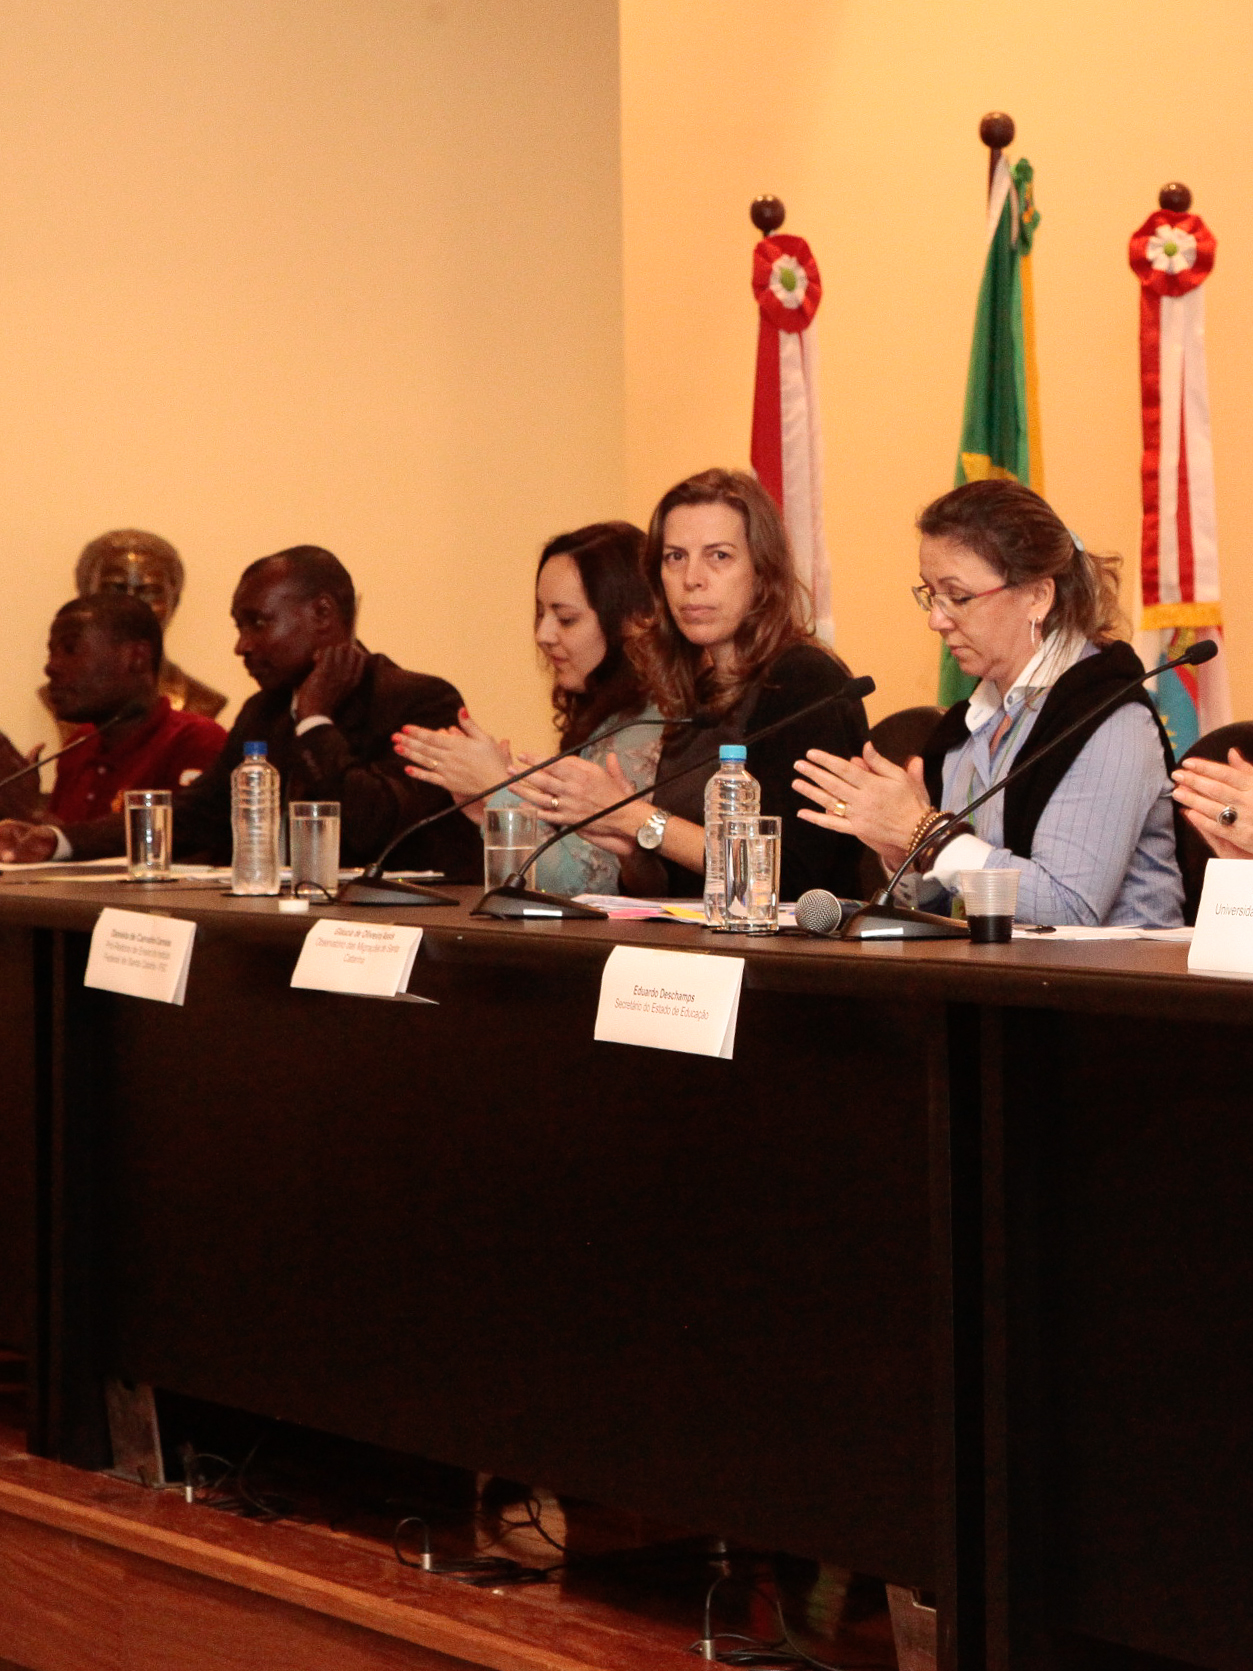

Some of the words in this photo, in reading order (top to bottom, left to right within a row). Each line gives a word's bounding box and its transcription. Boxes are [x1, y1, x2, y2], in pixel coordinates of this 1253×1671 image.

[633, 984, 659, 998] Eduardo
[659, 988, 696, 1004] Deschamps
[614, 997, 642, 1011] Secretário
[643, 1002, 651, 1012] do
[651, 1002, 671, 1015] Estado
[671, 1005, 679, 1016] de
[680, 1006, 710, 1021] Educação
